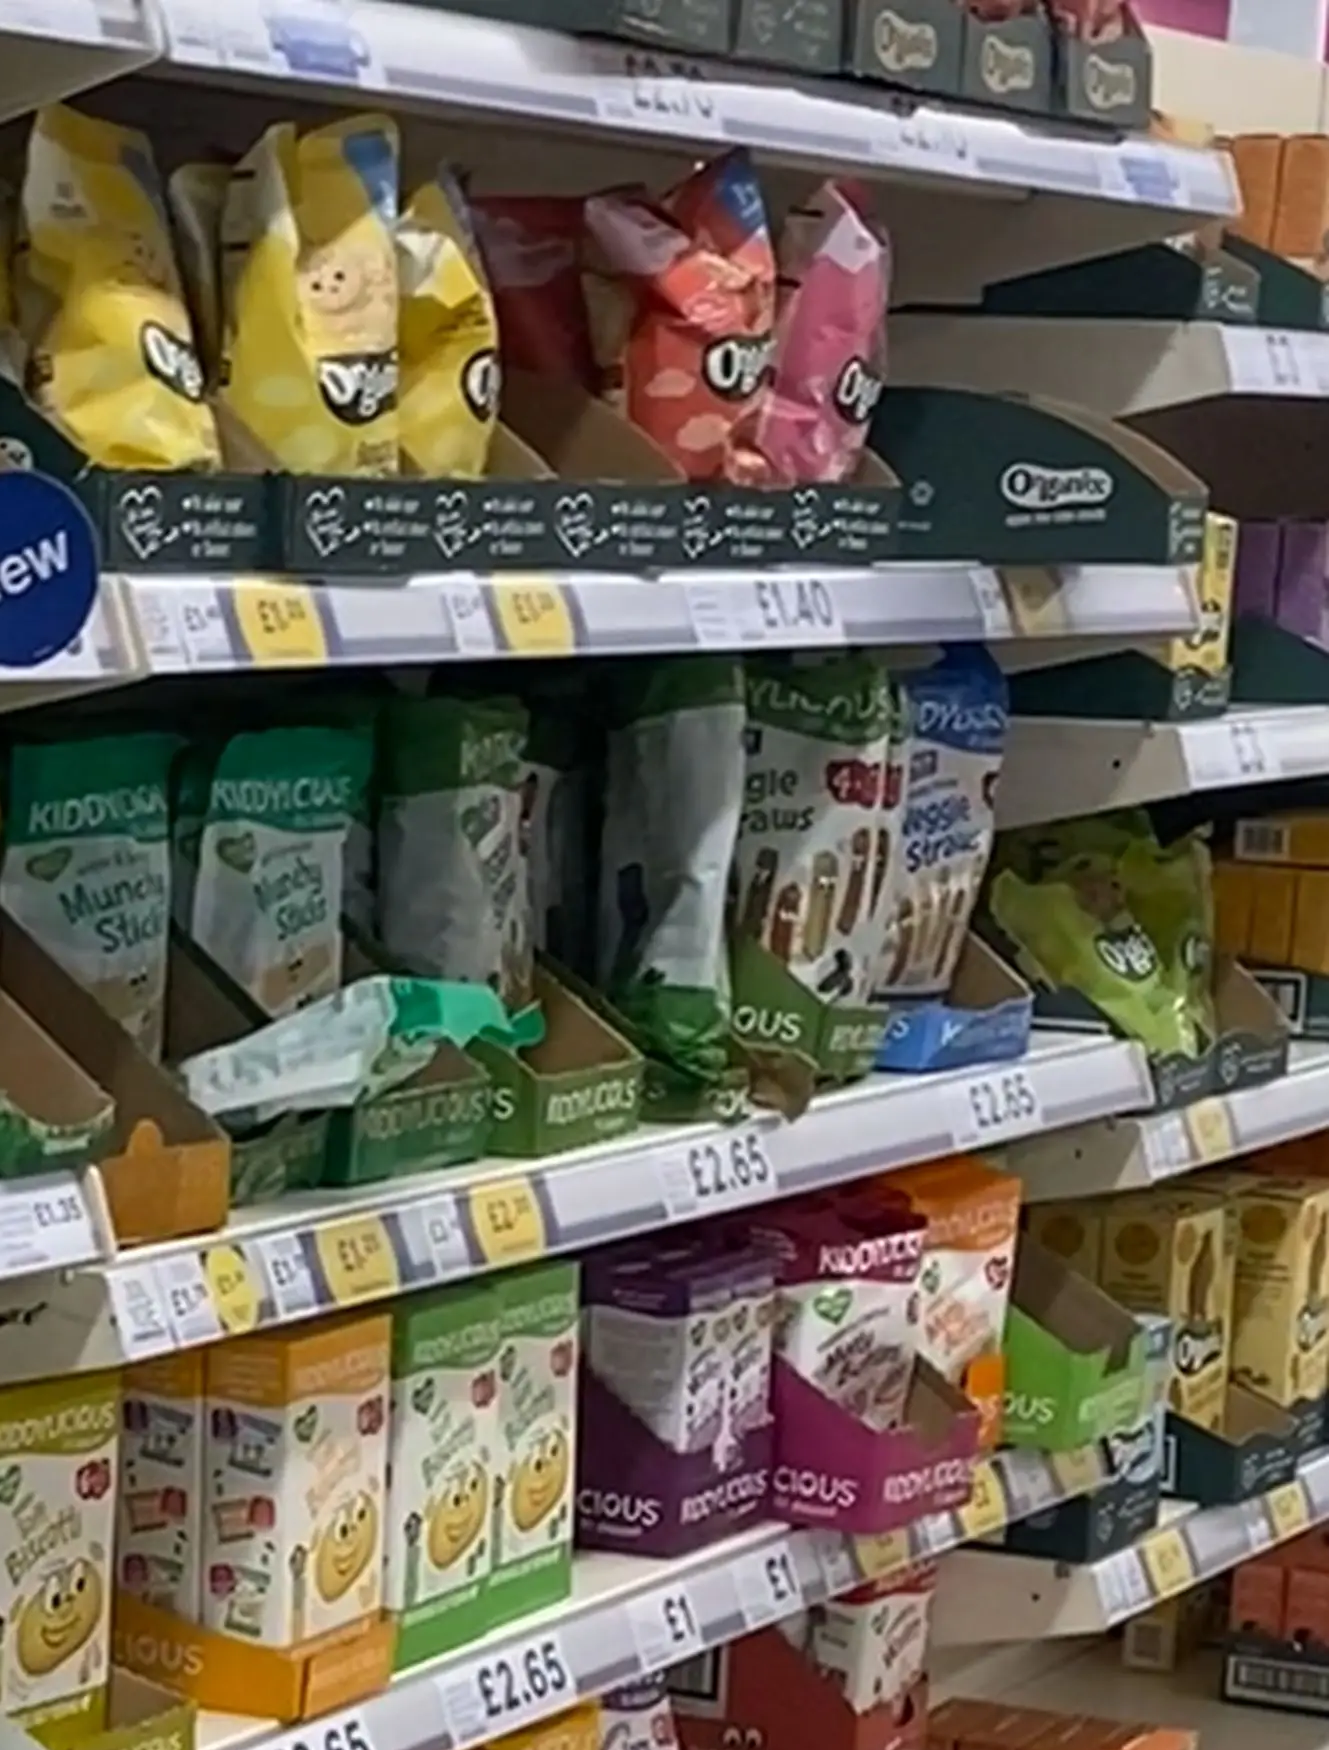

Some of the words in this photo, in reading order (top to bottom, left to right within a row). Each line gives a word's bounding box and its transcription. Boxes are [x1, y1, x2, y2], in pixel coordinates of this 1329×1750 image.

[730, 1003, 802, 1042] OUS
[969, 1083, 1038, 1134] £2.65
[688, 1134, 770, 1199] £2.65
[35, 1195, 82, 1230] £1.35
[578, 1486, 662, 1527] CIOUS
[772, 1466, 859, 1508] CIOUS
[772, 1556, 796, 1599] £1
[666, 1597, 695, 1642] £1
[478, 1640, 570, 1719] £2.65
